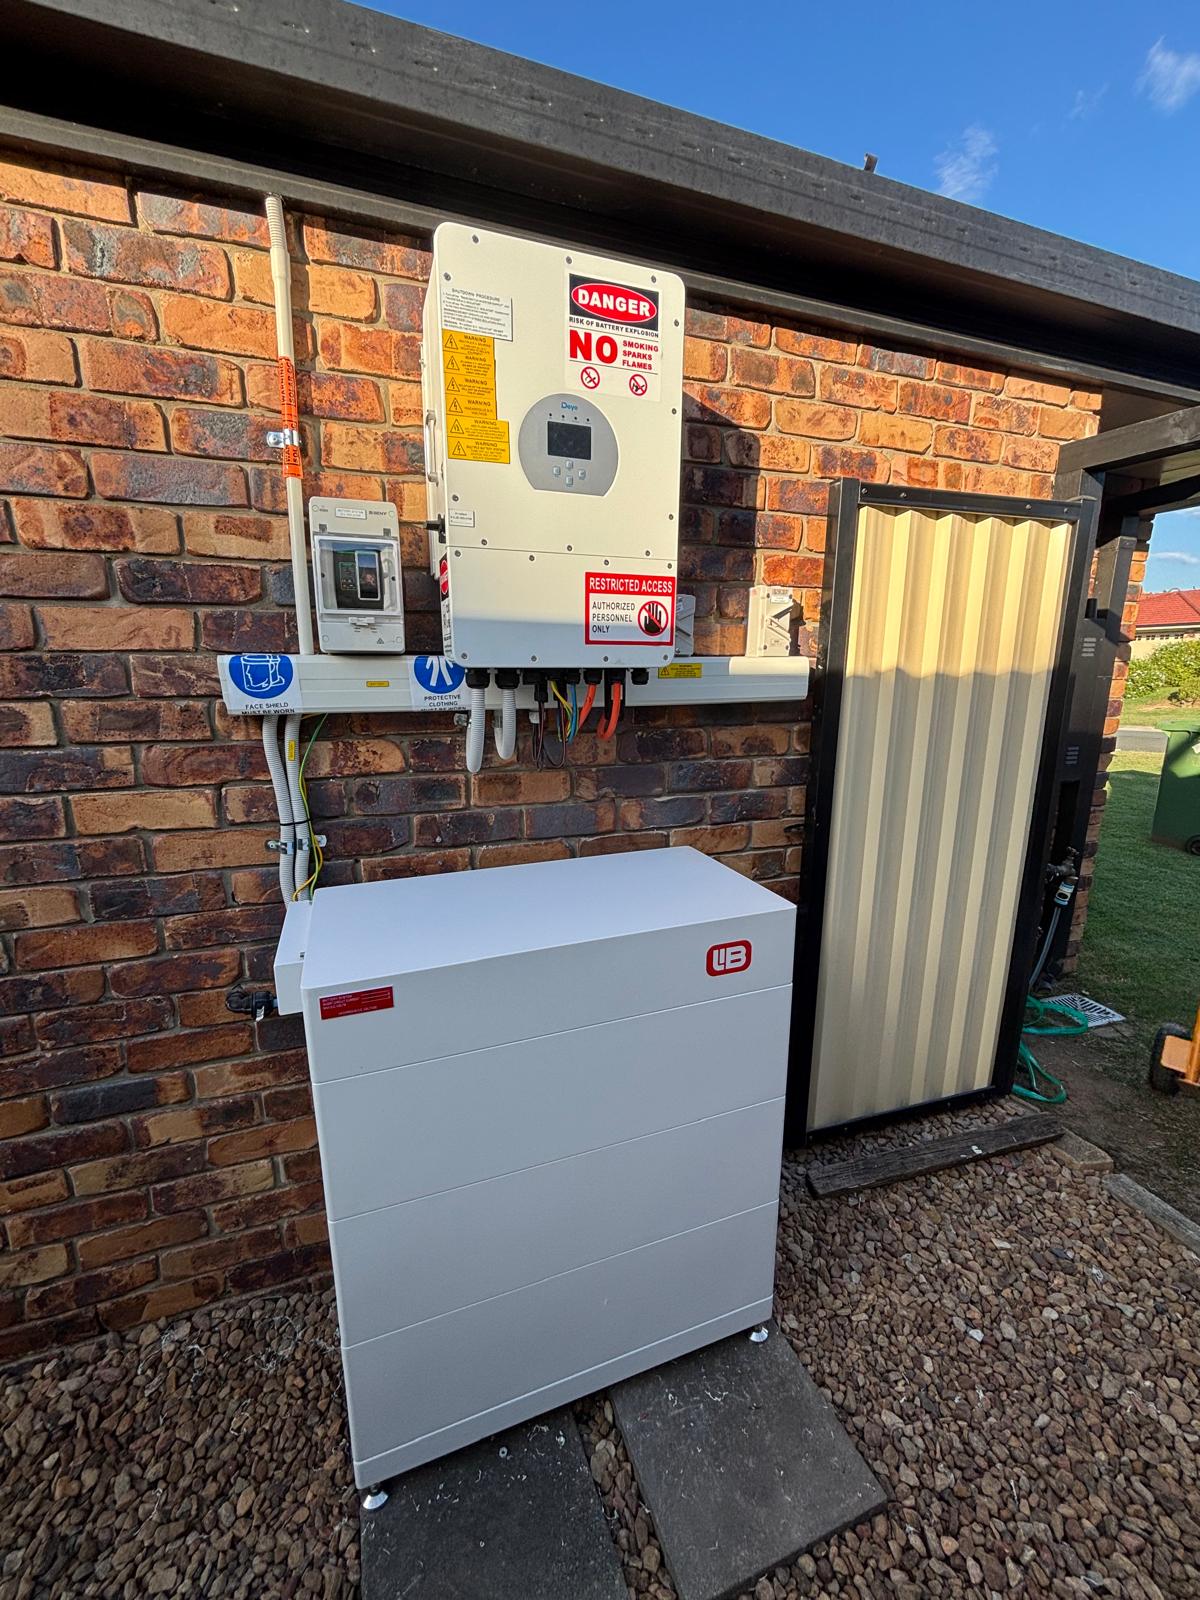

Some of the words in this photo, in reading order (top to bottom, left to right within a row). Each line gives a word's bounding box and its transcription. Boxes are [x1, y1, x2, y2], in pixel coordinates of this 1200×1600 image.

[577, 288, 651, 317] DANGER
[569, 316, 584, 325] RISK
[595, 321, 624, 333] BATTERY
[625, 327, 659, 338] EXPLOSION
[569, 329, 618, 364] NO
[622, 340, 659, 352] SMOKING
[622, 350, 653, 361] SPARKS
[622, 359, 653, 371] FLAMES
[589, 577, 640, 592] RESTRICTED
[641, 580, 673, 593] ACCESS
[592, 601, 636, 611] AUTHORIZED
[592, 613, 633, 623] PERSONNEL
[592, 624, 610, 633] ONLY
